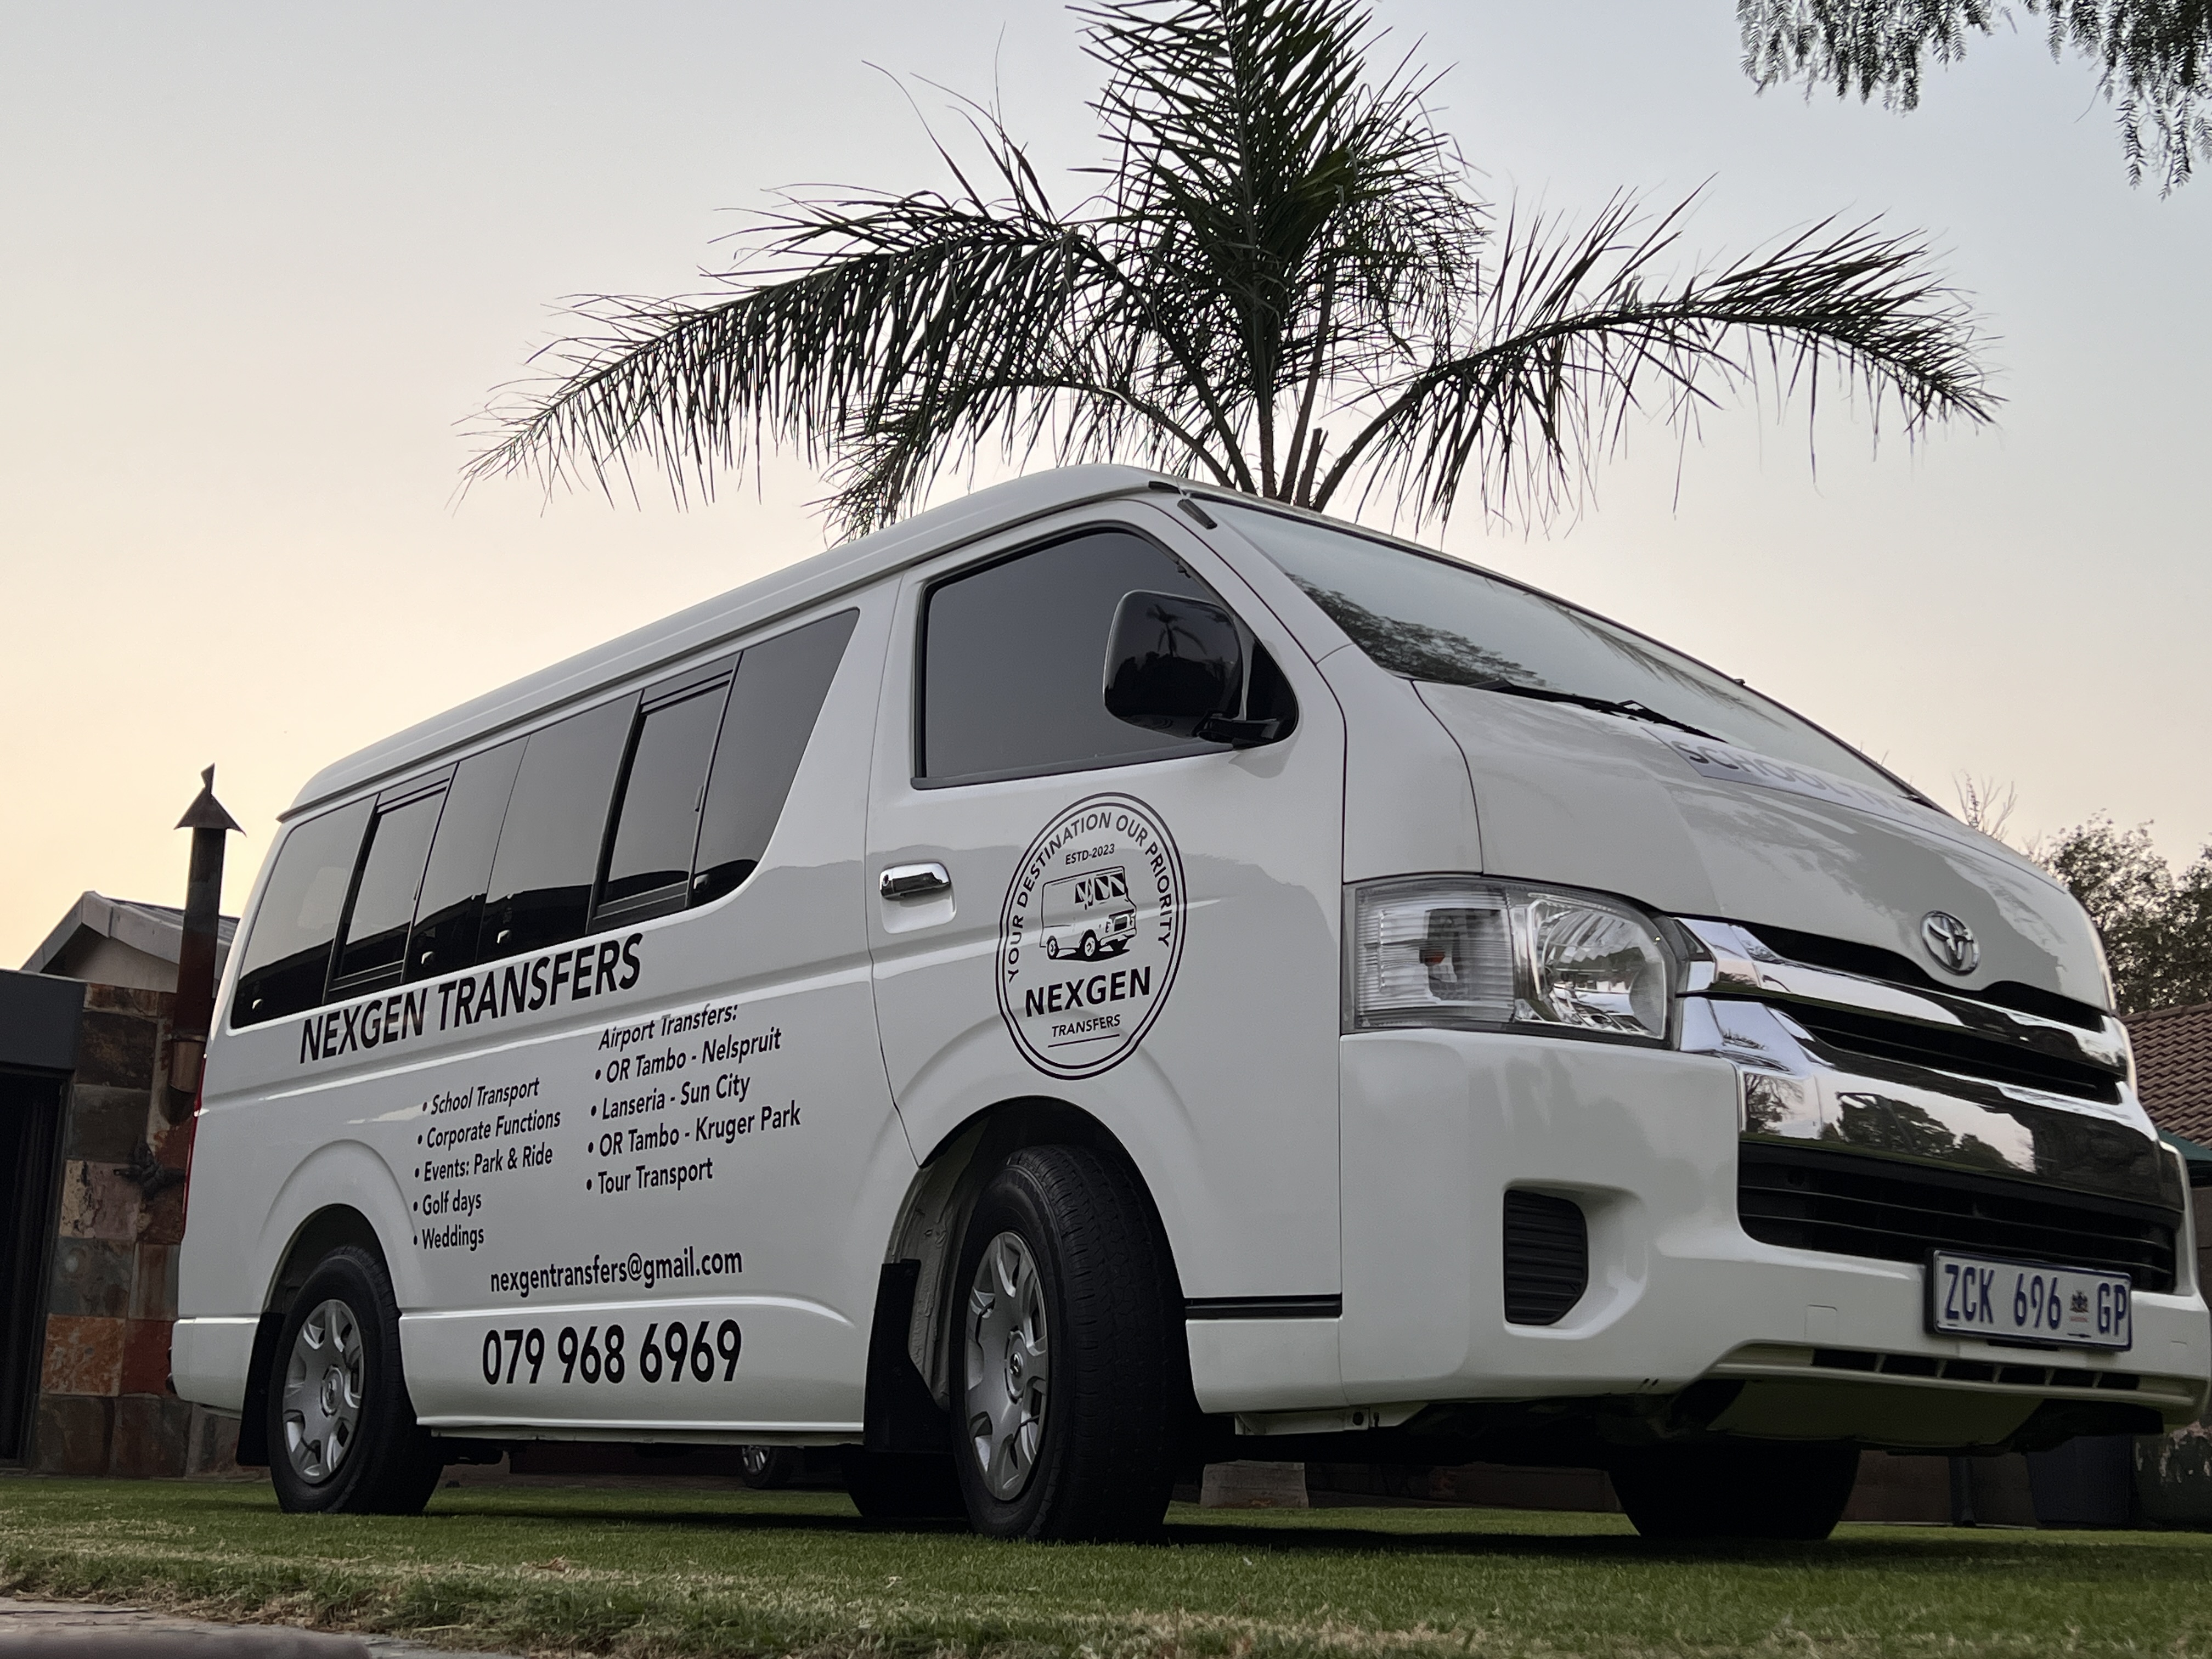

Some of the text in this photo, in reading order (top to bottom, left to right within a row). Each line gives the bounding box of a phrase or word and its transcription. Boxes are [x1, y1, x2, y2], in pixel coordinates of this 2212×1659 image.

[1671, 741, 1853, 797] SCHOOL
[1065, 843, 1115, 865] ESTD-2023
[1008, 812, 1173, 984] YOUR DESTINATION OUR PRIORITY
[299, 932, 644, 1064] NEXGEN TRANSFERS
[1025, 966, 1152, 1018] NEXGEN
[598, 1003, 738, 1052] Airport Transfers:
[1052, 1014, 1120, 1037] TRANSFERS
[607, 1058, 630, 1083] OR
[636, 1052, 686, 1077] Tambo
[702, 1026, 782, 1064] Nelspruit
[431, 1077, 540, 1115] School Transport
[602, 1093, 665, 1120] Lanseria
[680, 1081, 710, 1105] Sun
[716, 1073, 751, 1103] City
[427, 1109, 561, 1151] Corporate Functions
[600, 1132, 623, 1156] OR
[628, 1122, 679, 1152] Tambo
[696, 1115, 755, 1144] Kruger
[761, 1100, 800, 1131] Park
[424, 1142, 552, 1182] Events: Park & Ride
[598, 1158, 713, 1194] Tour Transport
[422, 1189, 481, 1217] Golf days
[422, 1224, 484, 1251] Weddings
[491, 1246, 743, 1298] nexgentransfers@gmail.com
[1945, 1264, 2126, 1336] ZCK 696 GP
[483, 1319, 741, 1385] 079 968 6969
